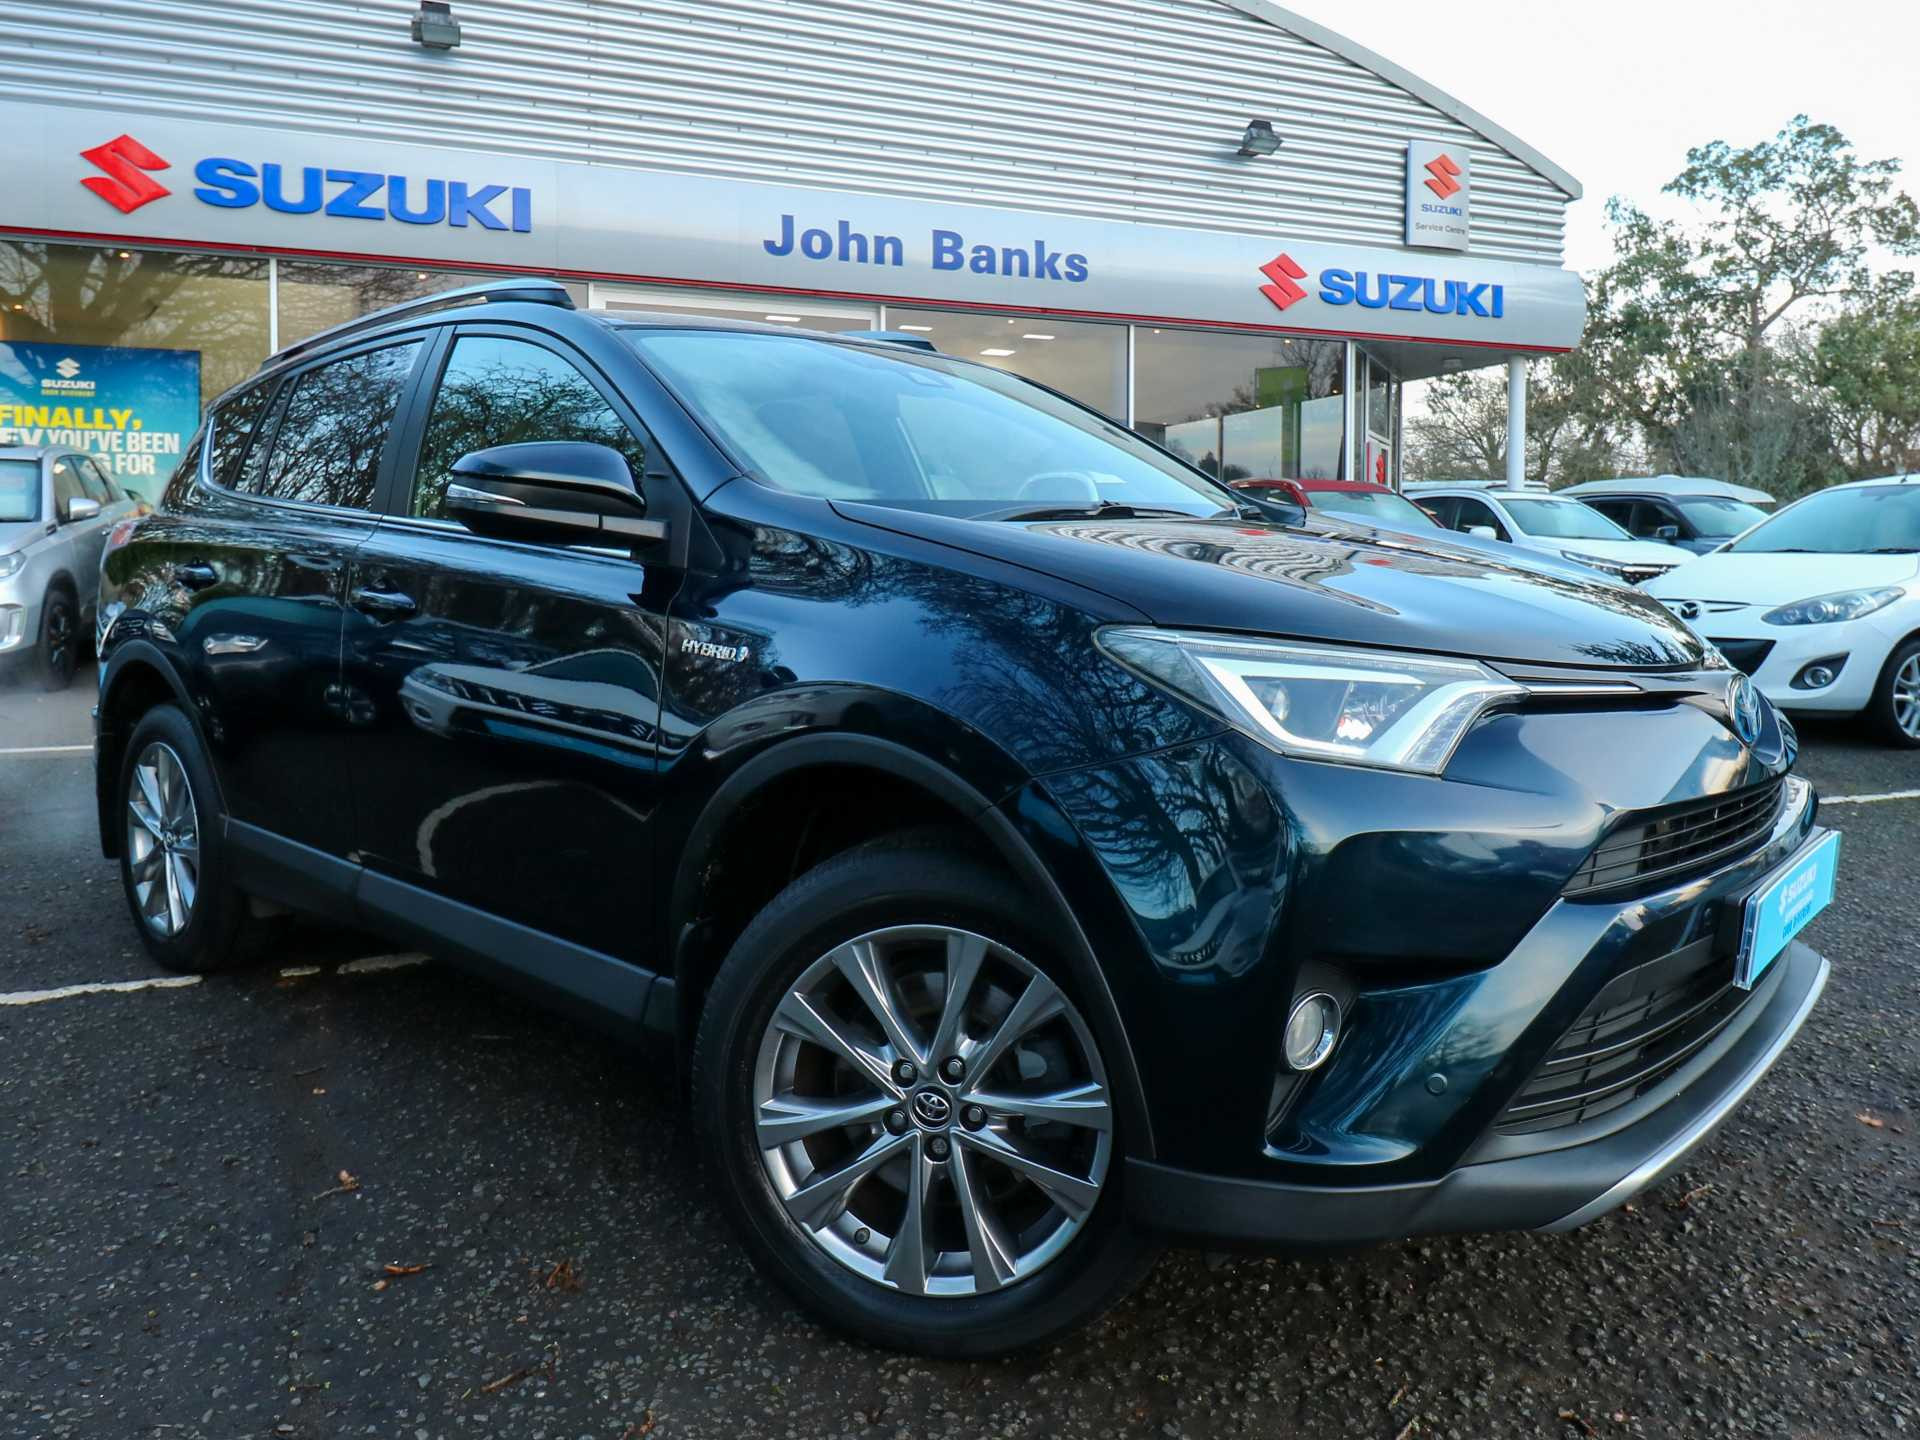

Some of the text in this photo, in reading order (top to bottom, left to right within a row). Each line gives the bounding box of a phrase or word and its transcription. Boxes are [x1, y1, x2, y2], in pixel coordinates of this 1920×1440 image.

[194, 158, 532, 233] SUZUKI
[1421, 203, 1462, 216] SUZUKI
[1415, 222, 1443, 232] Service
[763, 214, 1089, 283] John Banks
[1319, 269, 1503, 318] SUZUKI
[41, 379, 96, 390] SUZUKI
[0, 404, 143, 431] FINALLY,
[47, 429, 124, 453] YOU'VE
[126, 432, 180, 454] BEEN
[115, 453, 156, 476] FOR
[681, 638, 737, 661] HYBRID
